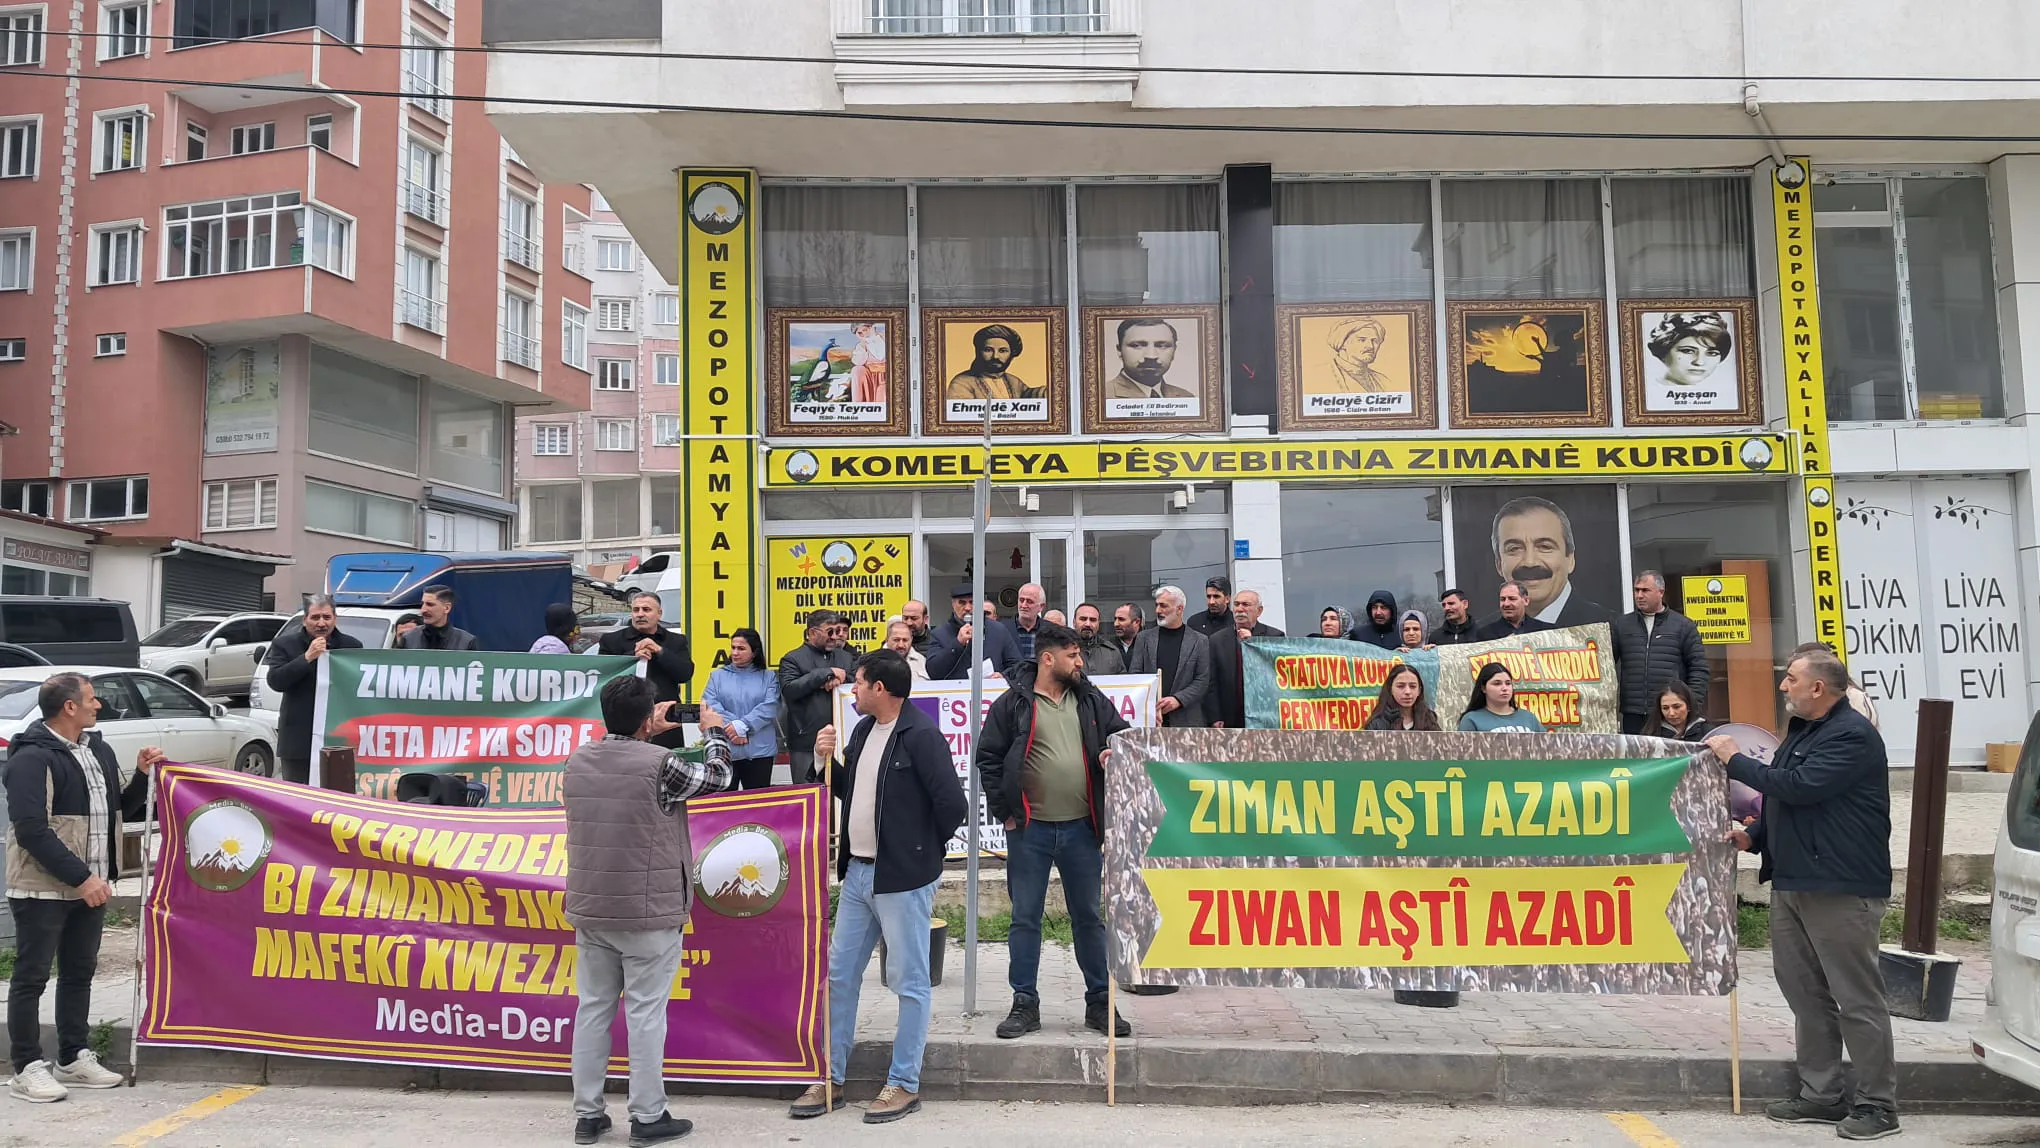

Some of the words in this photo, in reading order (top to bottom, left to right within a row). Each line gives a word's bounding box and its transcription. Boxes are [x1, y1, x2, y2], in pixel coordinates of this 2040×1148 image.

[1784, 192, 1819, 471] MEZOPOTAMYALILAR
[840, 403, 882, 414] Teyran
[1011, 402, 1041, 412] Xanî
[1666, 390, 1717, 400] Ayşeşan
[707, 243, 730, 668] MEZOPOTAMYALILA
[831, 453, 1069, 477] KOMELEYA
[1098, 447, 1394, 479] PÊŞVEBIRINA
[1407, 442, 1581, 470] ZIMANÊ
[1597, 442, 1733, 468] KURDÎ
[777, 575, 902, 590] MEZOPOTAMYALILAR
[819, 593, 833, 606] VE
[836, 590, 883, 606] KÜLTÜR
[1814, 521, 1838, 657] DERNE
[1845, 573, 1907, 610] LİVA
[1944, 572, 2006, 608] LİVA
[871, 610, 886, 622] VE
[1846, 618, 1921, 654] DİKİM
[1940, 616, 2019, 654] DİKİM
[357, 660, 483, 701] ZIMANÊ
[492, 667, 601, 702] KURDÎ
[1276, 655, 1352, 689] STATUYA
[1354, 656, 1402, 686] KUR
[1861, 663, 1907, 700] EVİ
[1960, 662, 2005, 699] EVİ
[358, 724, 425, 758] XETA
[431, 726, 473, 758] ME
[479, 727, 509, 757] YA
[515, 725, 571, 758] SOR
[1189, 778, 1335, 835] ZIMAN
[1352, 767, 1467, 849] AŞTÎ
[1481, 767, 1633, 836] AZADÎ
[264, 862, 314, 915] BI
[319, 867, 495, 925] ZIMANÊ
[1188, 889, 1342, 947] ZIWAN
[1358, 877, 1470, 961] AŞTÎ
[1485, 876, 1635, 946] AZADÎ
[252, 926, 412, 989] MAFEKÎ
[376, 998, 571, 1044] Medîa-Der
